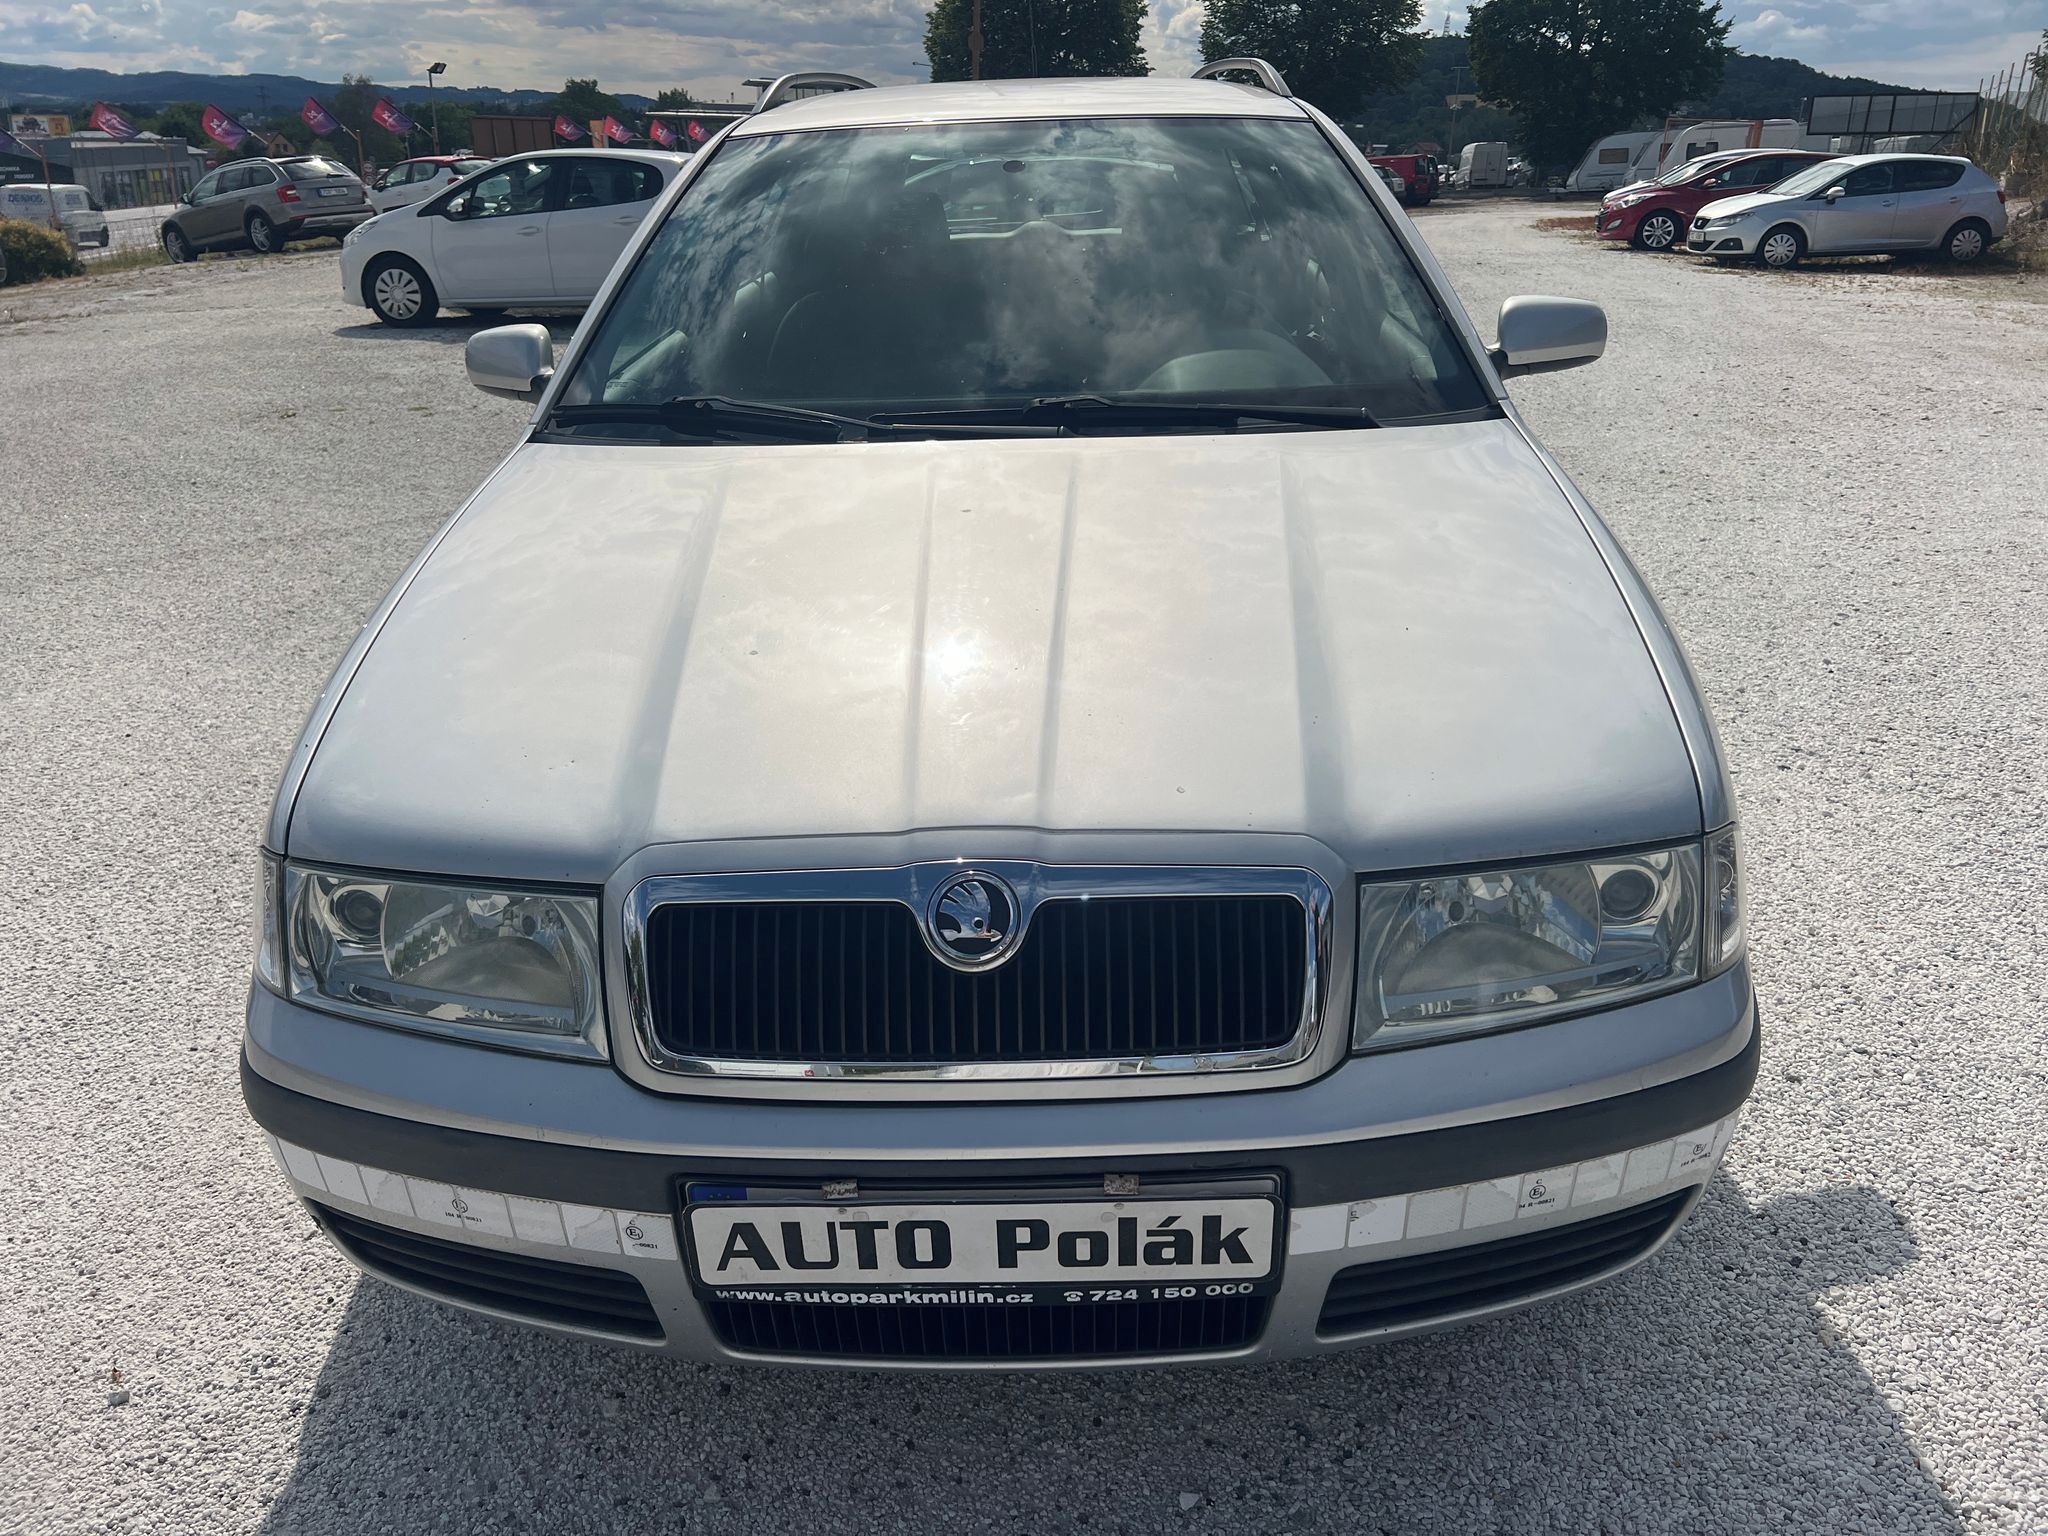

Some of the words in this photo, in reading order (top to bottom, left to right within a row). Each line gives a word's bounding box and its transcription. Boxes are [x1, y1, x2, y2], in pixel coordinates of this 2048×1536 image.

[716, 1219, 952, 1271] AUTO
[995, 1214, 1255, 1269] Polák
[715, 1289, 1034, 1306] www.autoparkmilin.cz
[1089, 1288, 1139, 1302] 724
[1151, 1286, 1197, 1299] 150
[1205, 1282, 1254, 1296] 000
